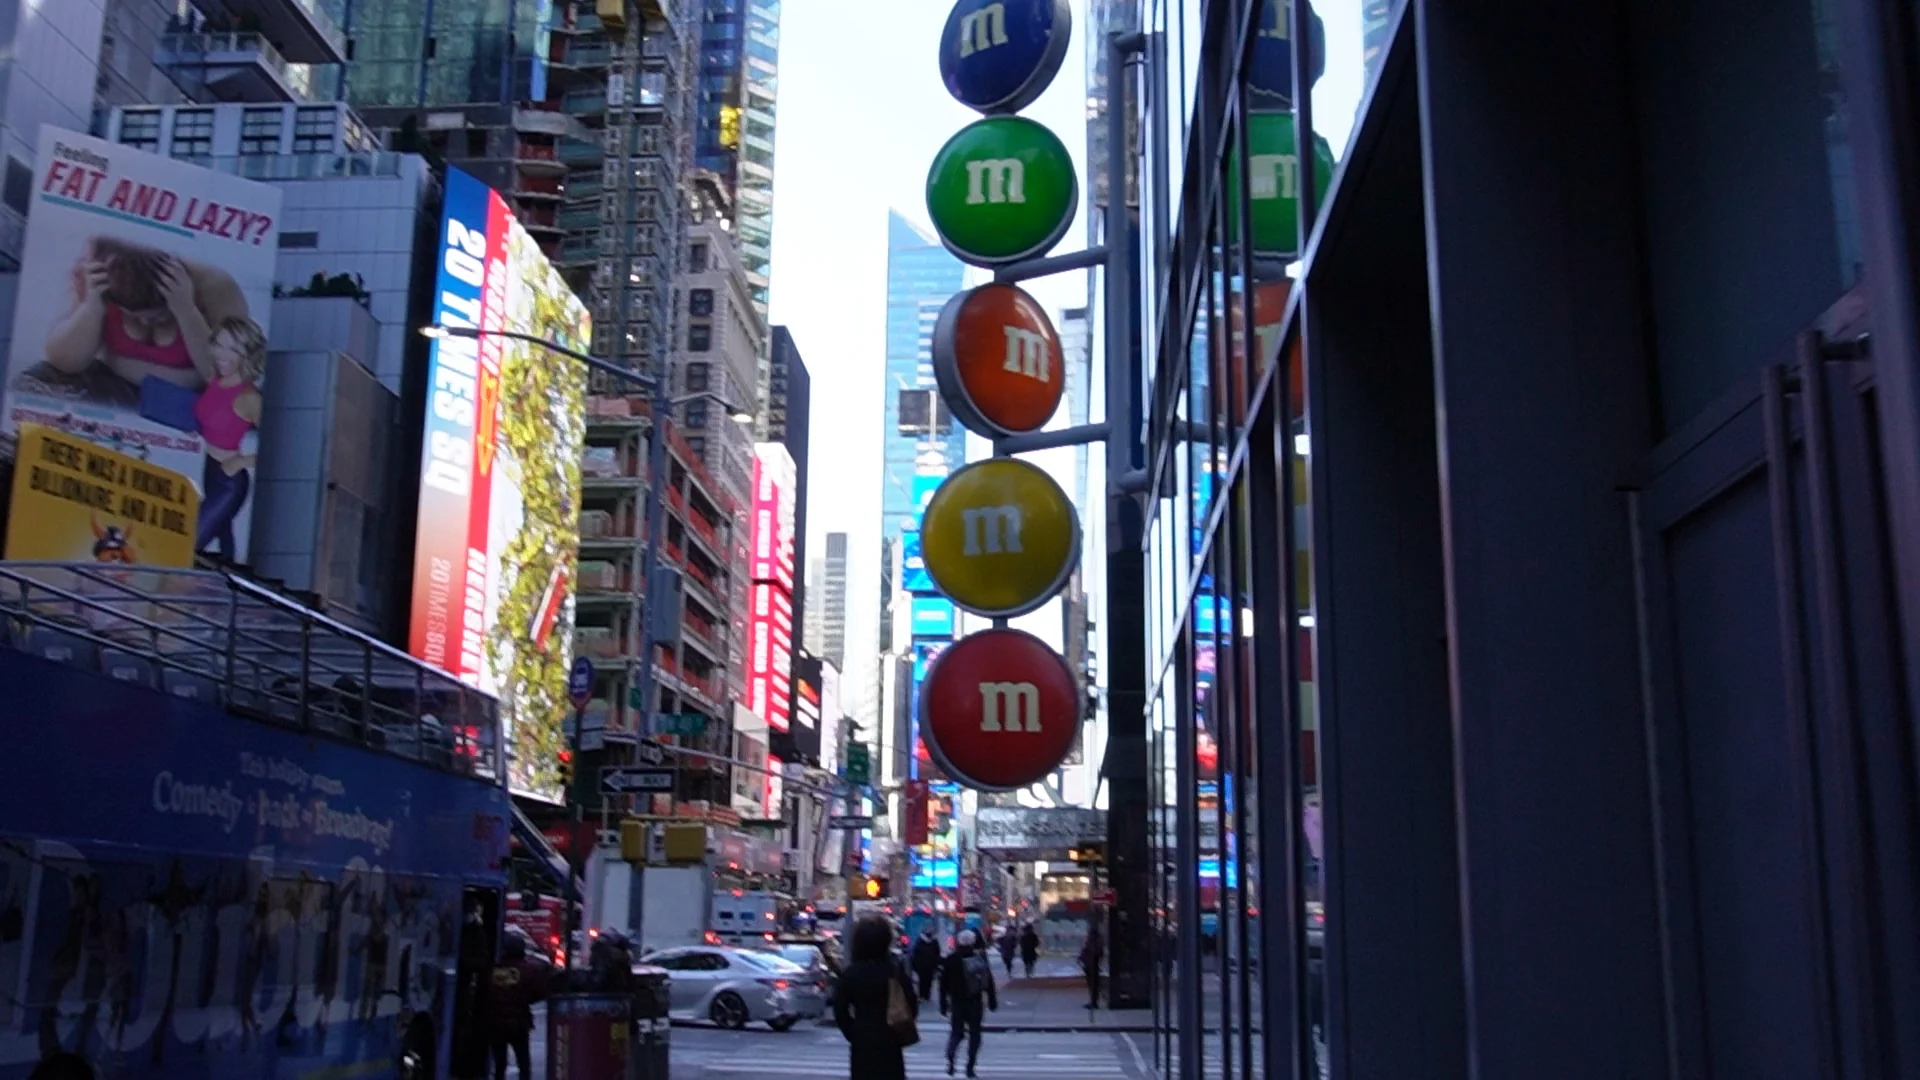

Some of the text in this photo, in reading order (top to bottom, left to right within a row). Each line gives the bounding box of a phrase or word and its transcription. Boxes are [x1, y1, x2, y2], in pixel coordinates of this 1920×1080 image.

[960, 2, 1008, 58] m
[53, 141, 110, 171] Feeling
[965, 157, 1026, 204] m
[43, 160, 273, 246] FAT AND LAZY?
[424, 217, 488, 497] 20 TIMES SQ
[1003, 325, 1050, 384] m
[961, 504, 1023, 557] m
[979, 681, 1042, 733] m
[152, 770, 244, 835] Comedy
